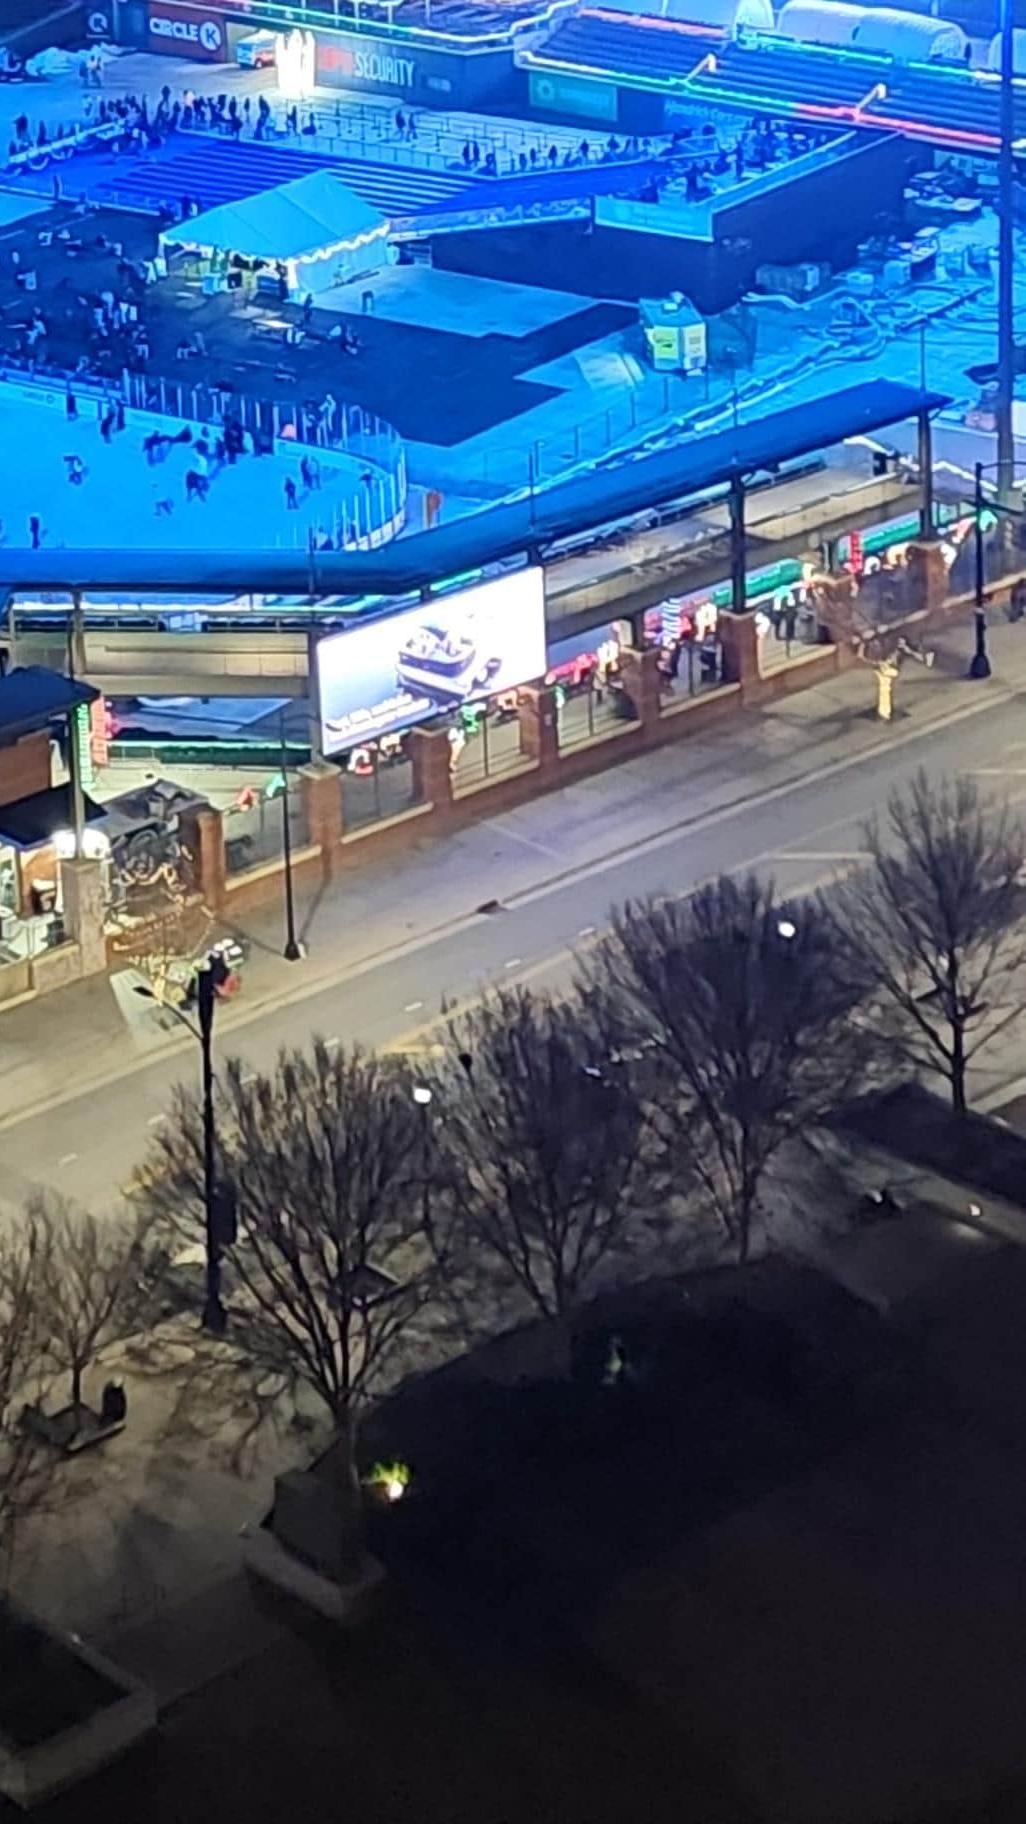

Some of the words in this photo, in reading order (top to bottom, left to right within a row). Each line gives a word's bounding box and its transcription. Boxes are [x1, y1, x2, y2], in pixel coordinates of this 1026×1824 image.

[149, 17, 199, 42] CIRCLE
[201, 23, 220, 50] K
[354, 51, 414, 87] SECURITY
